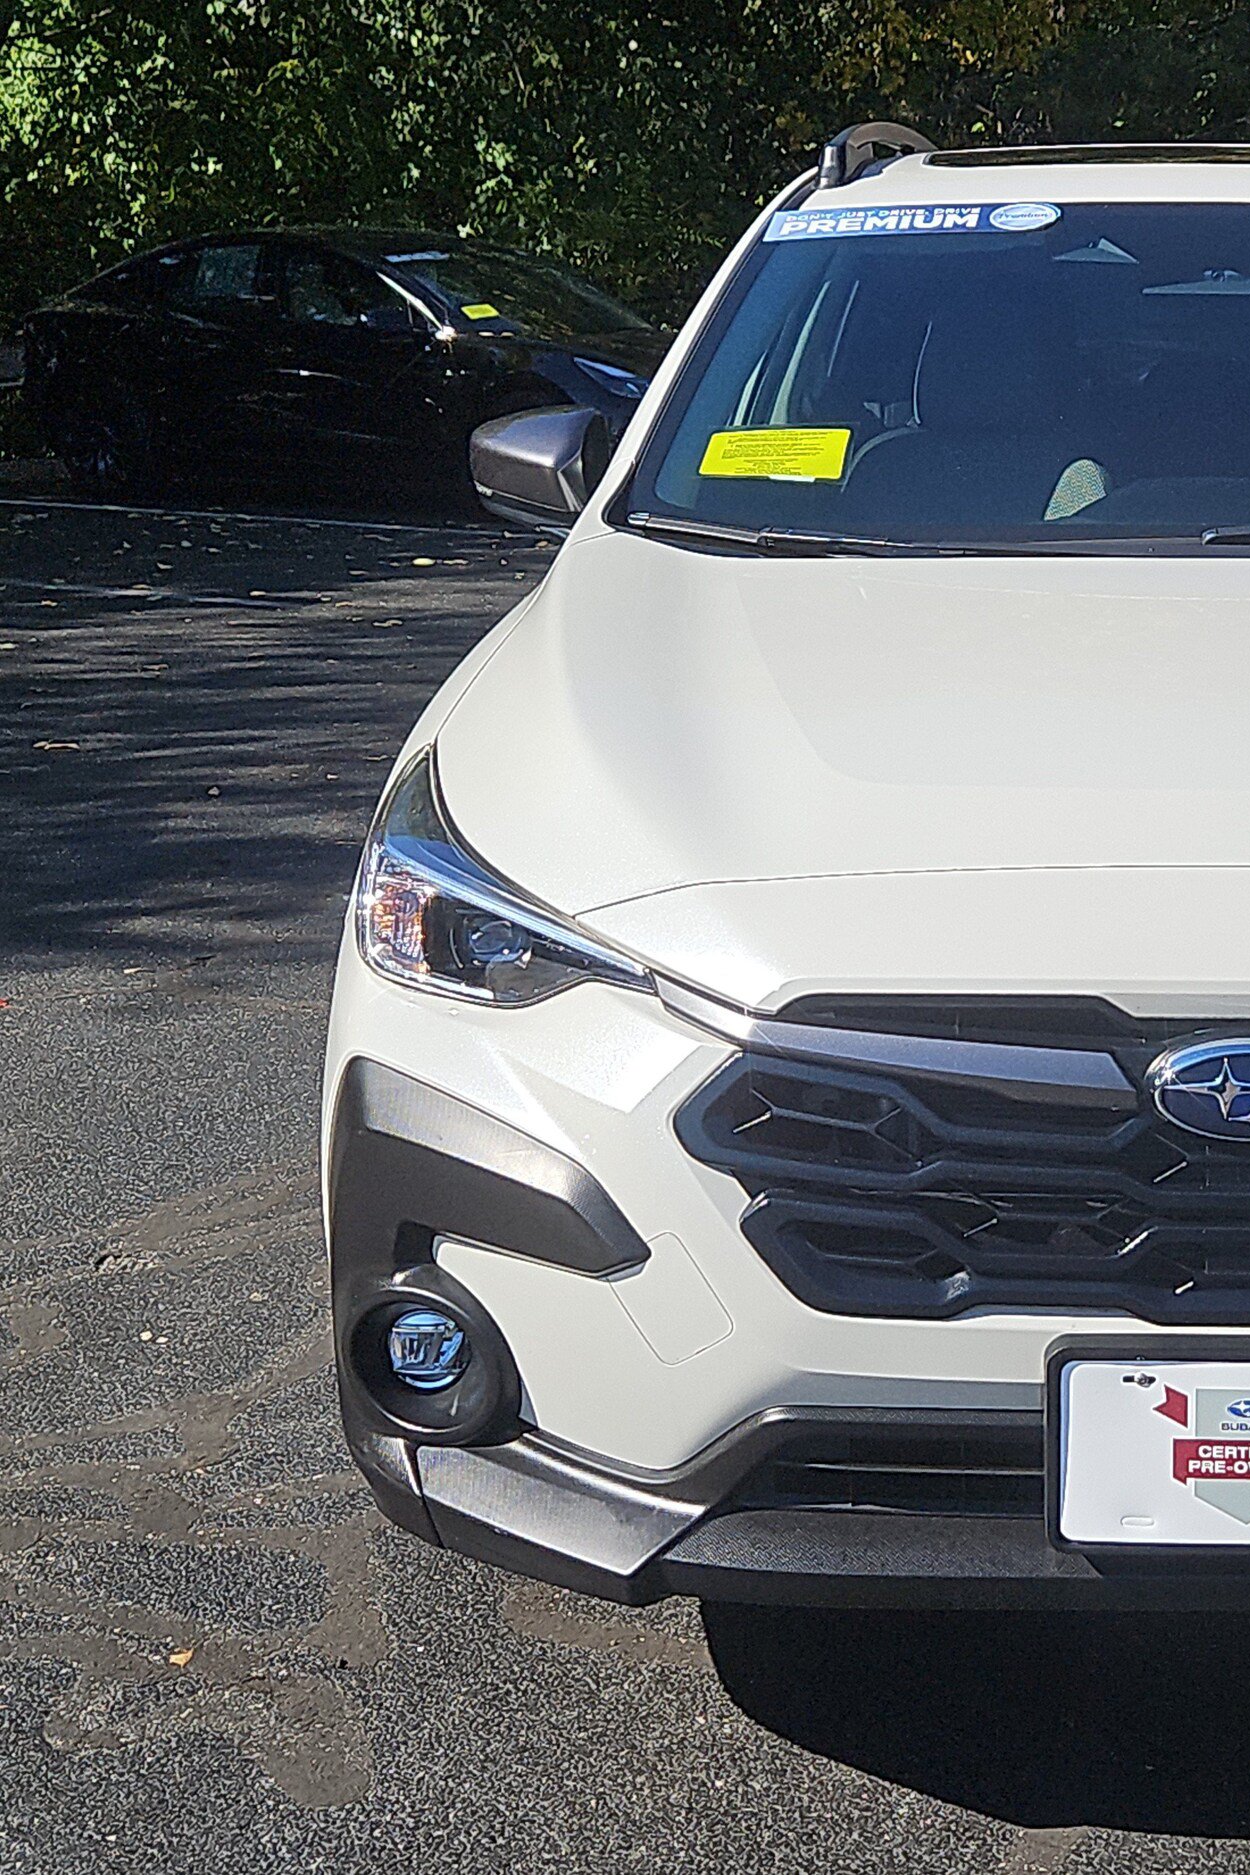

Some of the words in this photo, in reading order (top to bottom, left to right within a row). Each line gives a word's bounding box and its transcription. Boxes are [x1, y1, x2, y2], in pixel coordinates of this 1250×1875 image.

[786, 213, 833, 222] DON'T
[837, 210, 875, 219] JUST
[933, 207, 982, 215] DRIVE
[779, 214, 981, 236] PREMIUM
